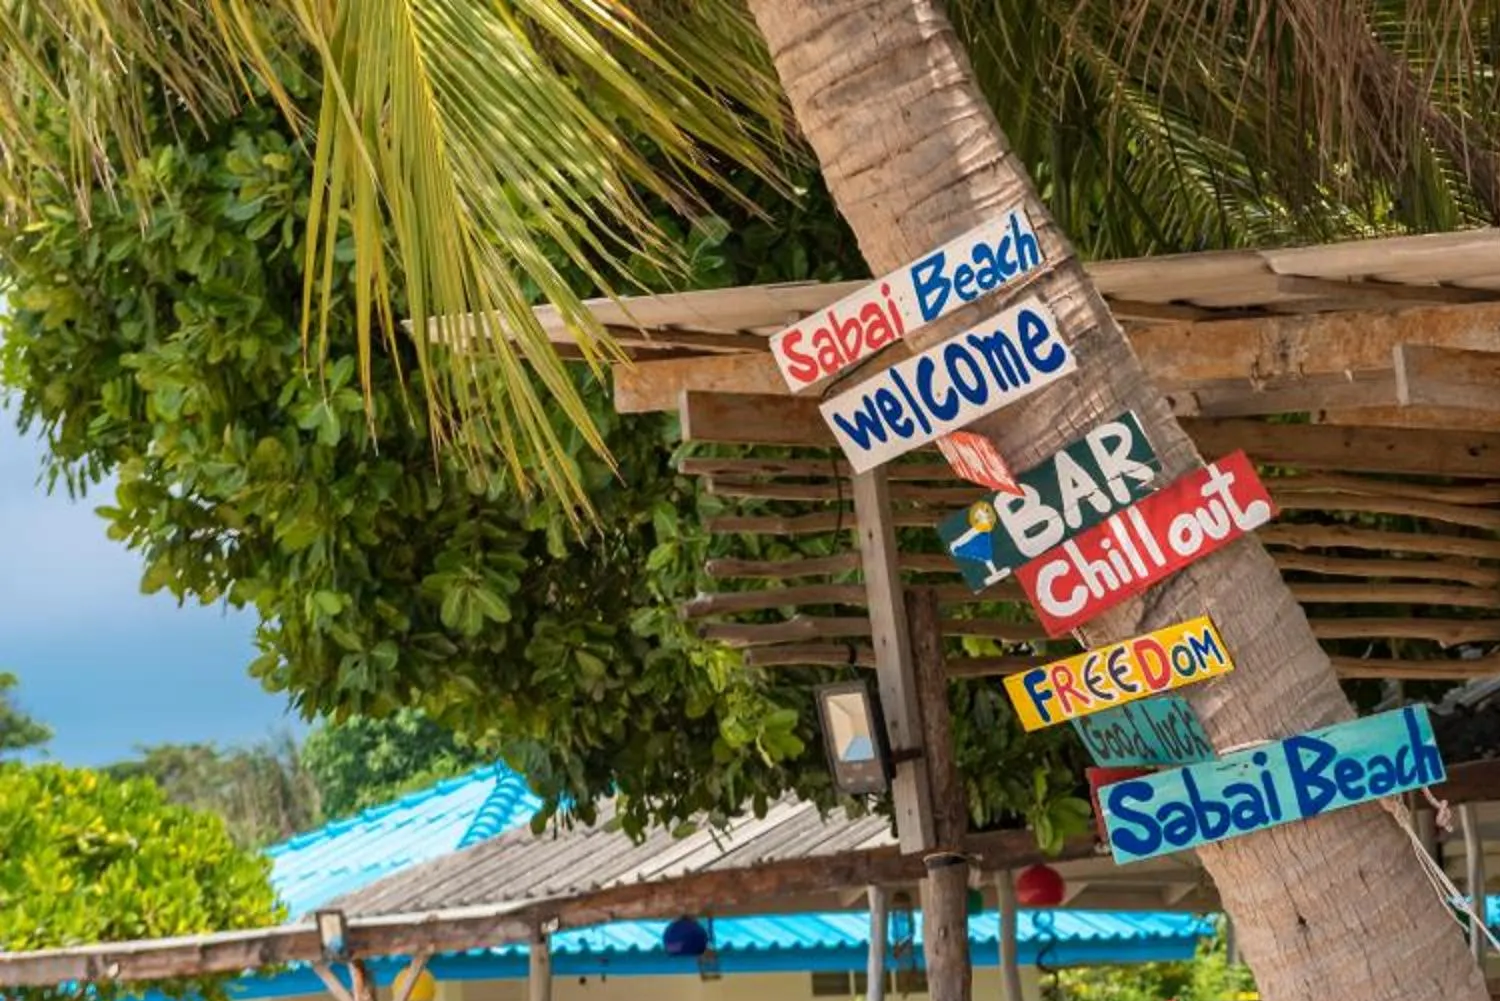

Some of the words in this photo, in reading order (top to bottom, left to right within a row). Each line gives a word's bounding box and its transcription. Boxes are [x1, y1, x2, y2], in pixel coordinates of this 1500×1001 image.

[782, 283, 905, 383] Sabai
[911, 213, 1040, 323] Beach
[994, 422, 1155, 558] BAR
[1036, 506, 1167, 617] Chill
[1168, 463, 1271, 556] out
[1023, 628, 1225, 723] FREEDOM
[1080, 704, 1158, 760] Good
[1108, 752, 1283, 856] Sabai
[1284, 708, 1442, 818] Beach
